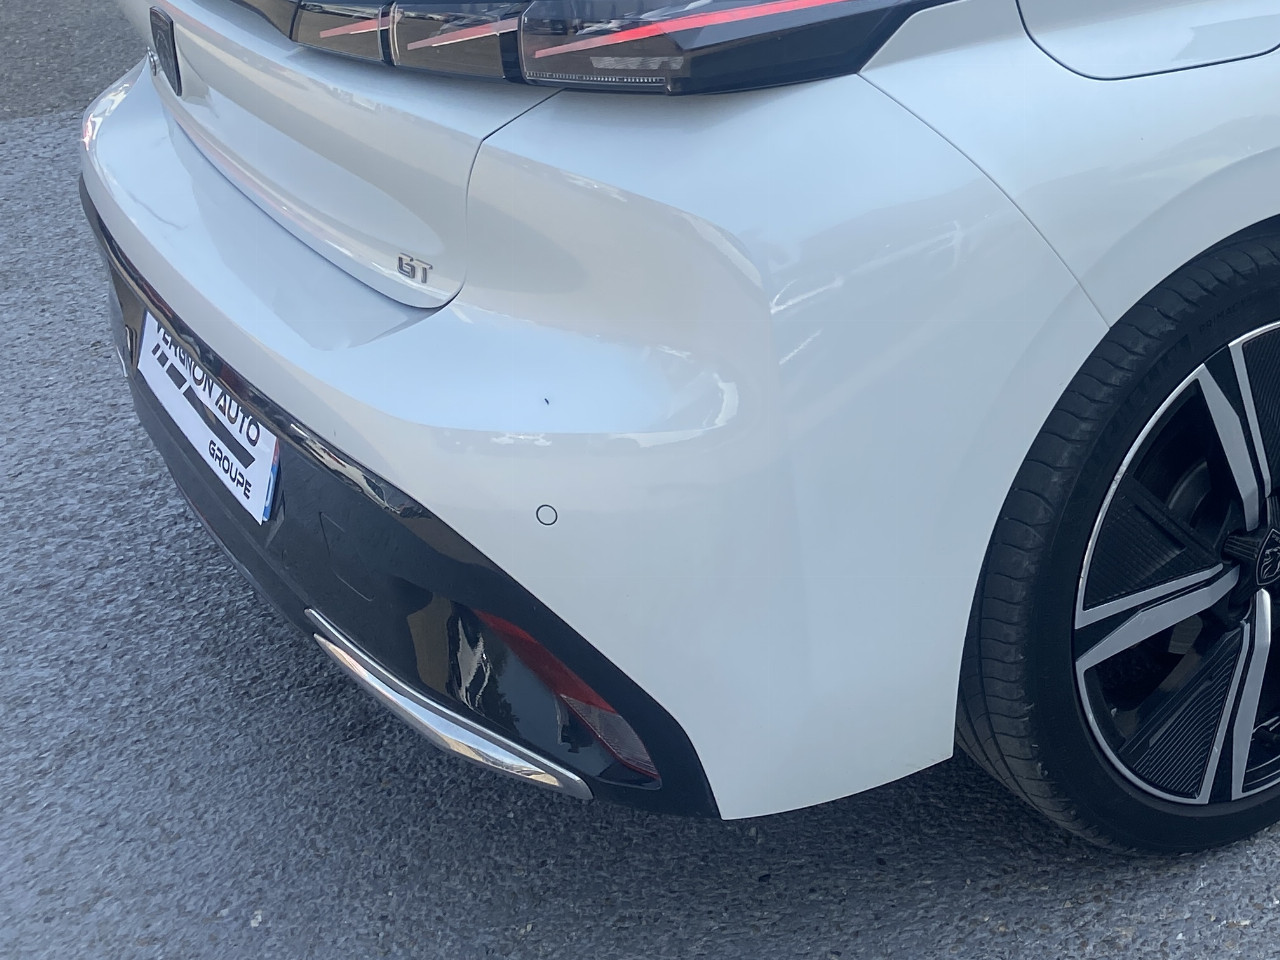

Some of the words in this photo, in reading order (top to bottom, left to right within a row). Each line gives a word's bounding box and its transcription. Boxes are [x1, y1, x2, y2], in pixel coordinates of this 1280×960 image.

[398, 252, 433, 284] GT
[214, 390, 262, 448] AUTO
[208, 438, 253, 500] GROUPE
